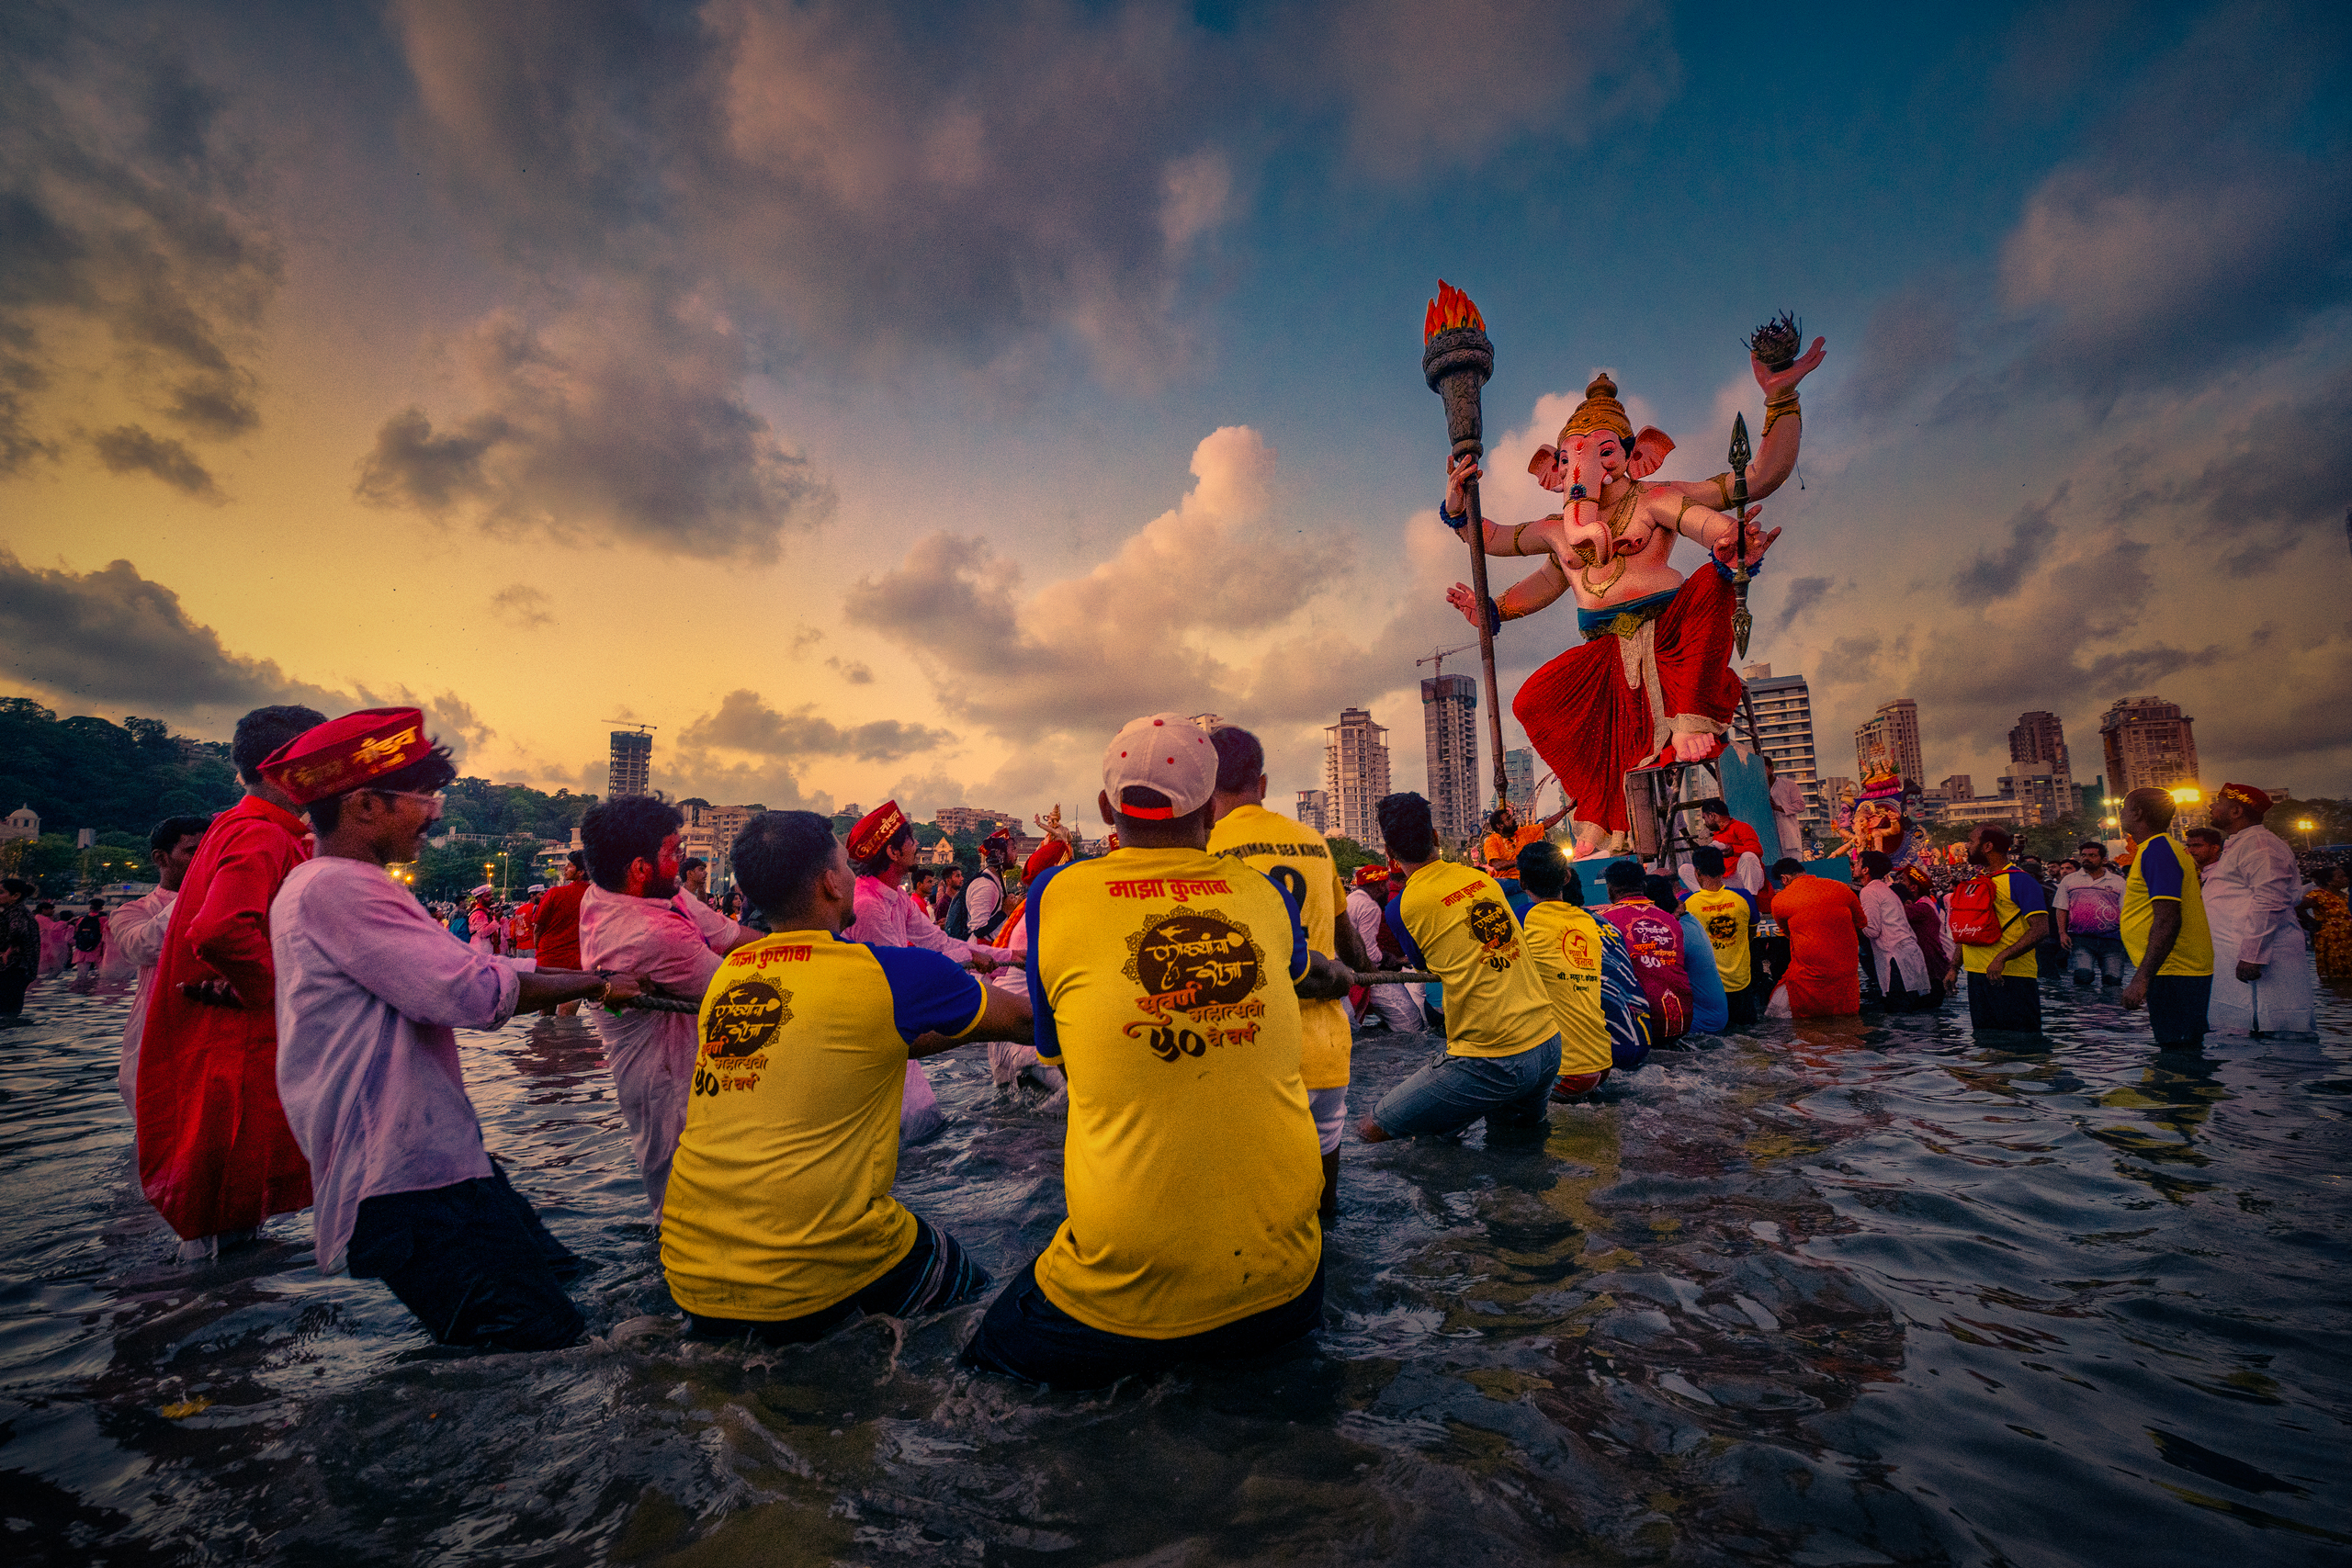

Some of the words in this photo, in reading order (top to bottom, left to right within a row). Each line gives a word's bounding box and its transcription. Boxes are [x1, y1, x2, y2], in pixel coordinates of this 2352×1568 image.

[1276, 842, 1298, 857] SEA
[1297, 842, 1328, 859] KINGS
[1105, 879, 1165, 899] माझा
[1166, 879, 1233, 902] कुलाबा
[1441, 890, 1465, 907] माझा
[1461, 880, 1487, 897] कुलाबा
[757, 945, 812, 969] कुलाबा
[1640, 954, 1661, 968] ५०
[1125, 981, 1203, 1031] सुवर्ण
[1186, 998, 1267, 1025] महोत्सवी
[1150, 1027, 1206, 1063] ५०
[1206, 1027, 1224, 1047] वे
[1224, 1021, 1261, 1045] वर्ष
[714, 1053, 769, 1073] महोत्सवी
[734, 1072, 761, 1092] वर्ष
